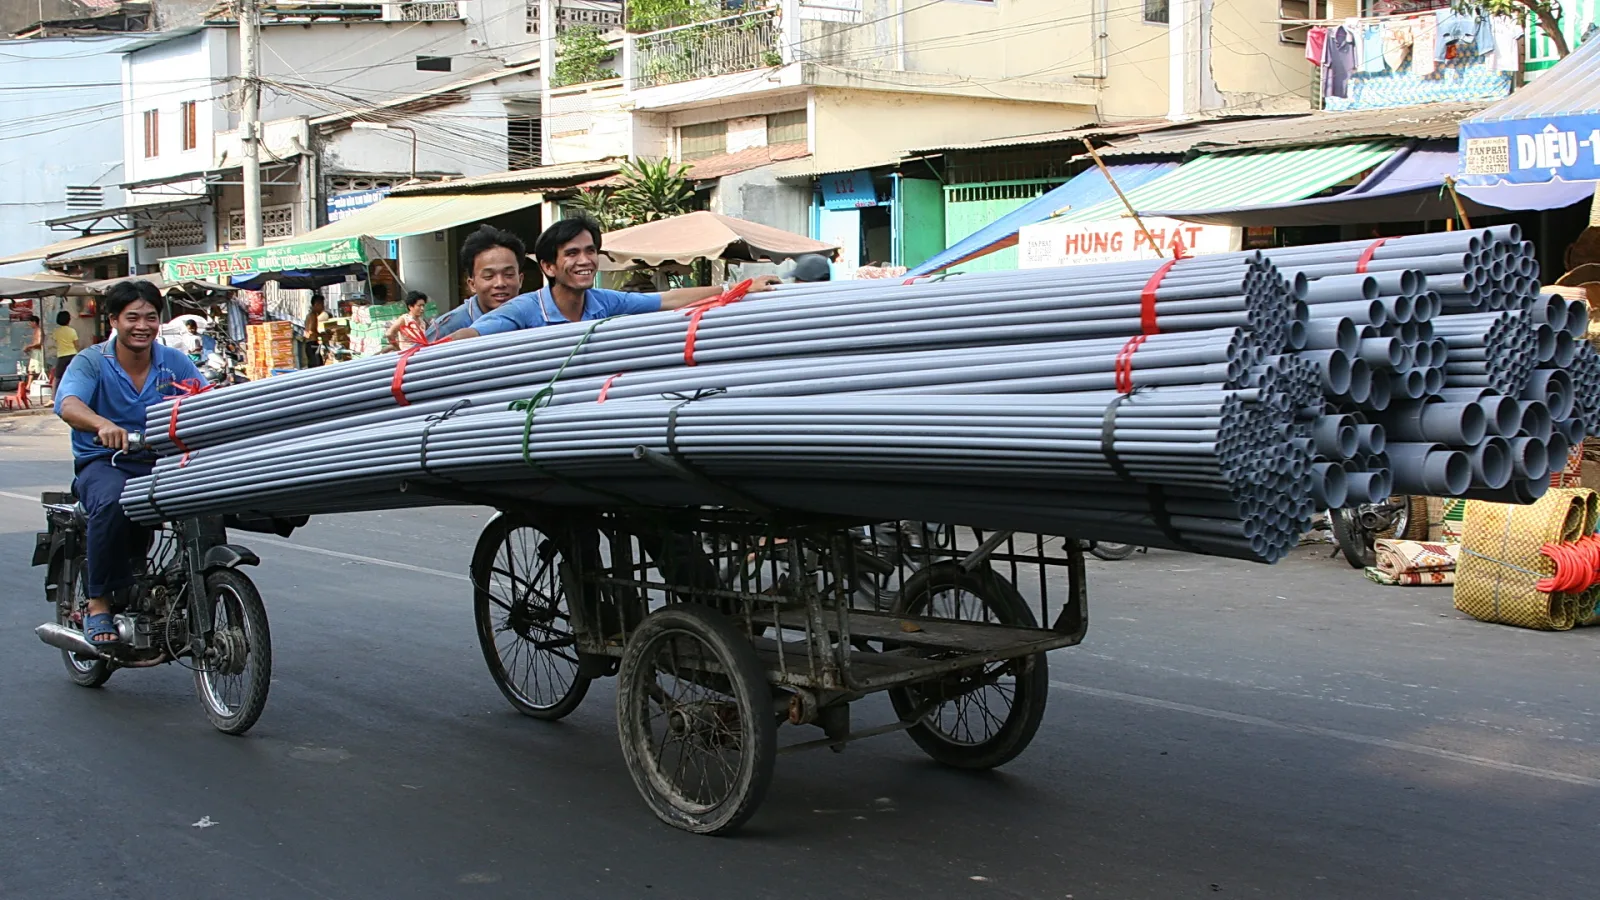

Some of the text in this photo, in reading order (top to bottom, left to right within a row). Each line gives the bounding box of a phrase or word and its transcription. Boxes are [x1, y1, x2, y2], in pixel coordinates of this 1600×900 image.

[1065, 227, 1123, 255] HÙNG
[1133, 222, 1203, 251] PHÁT
[207, 252, 254, 273] PHÁT
